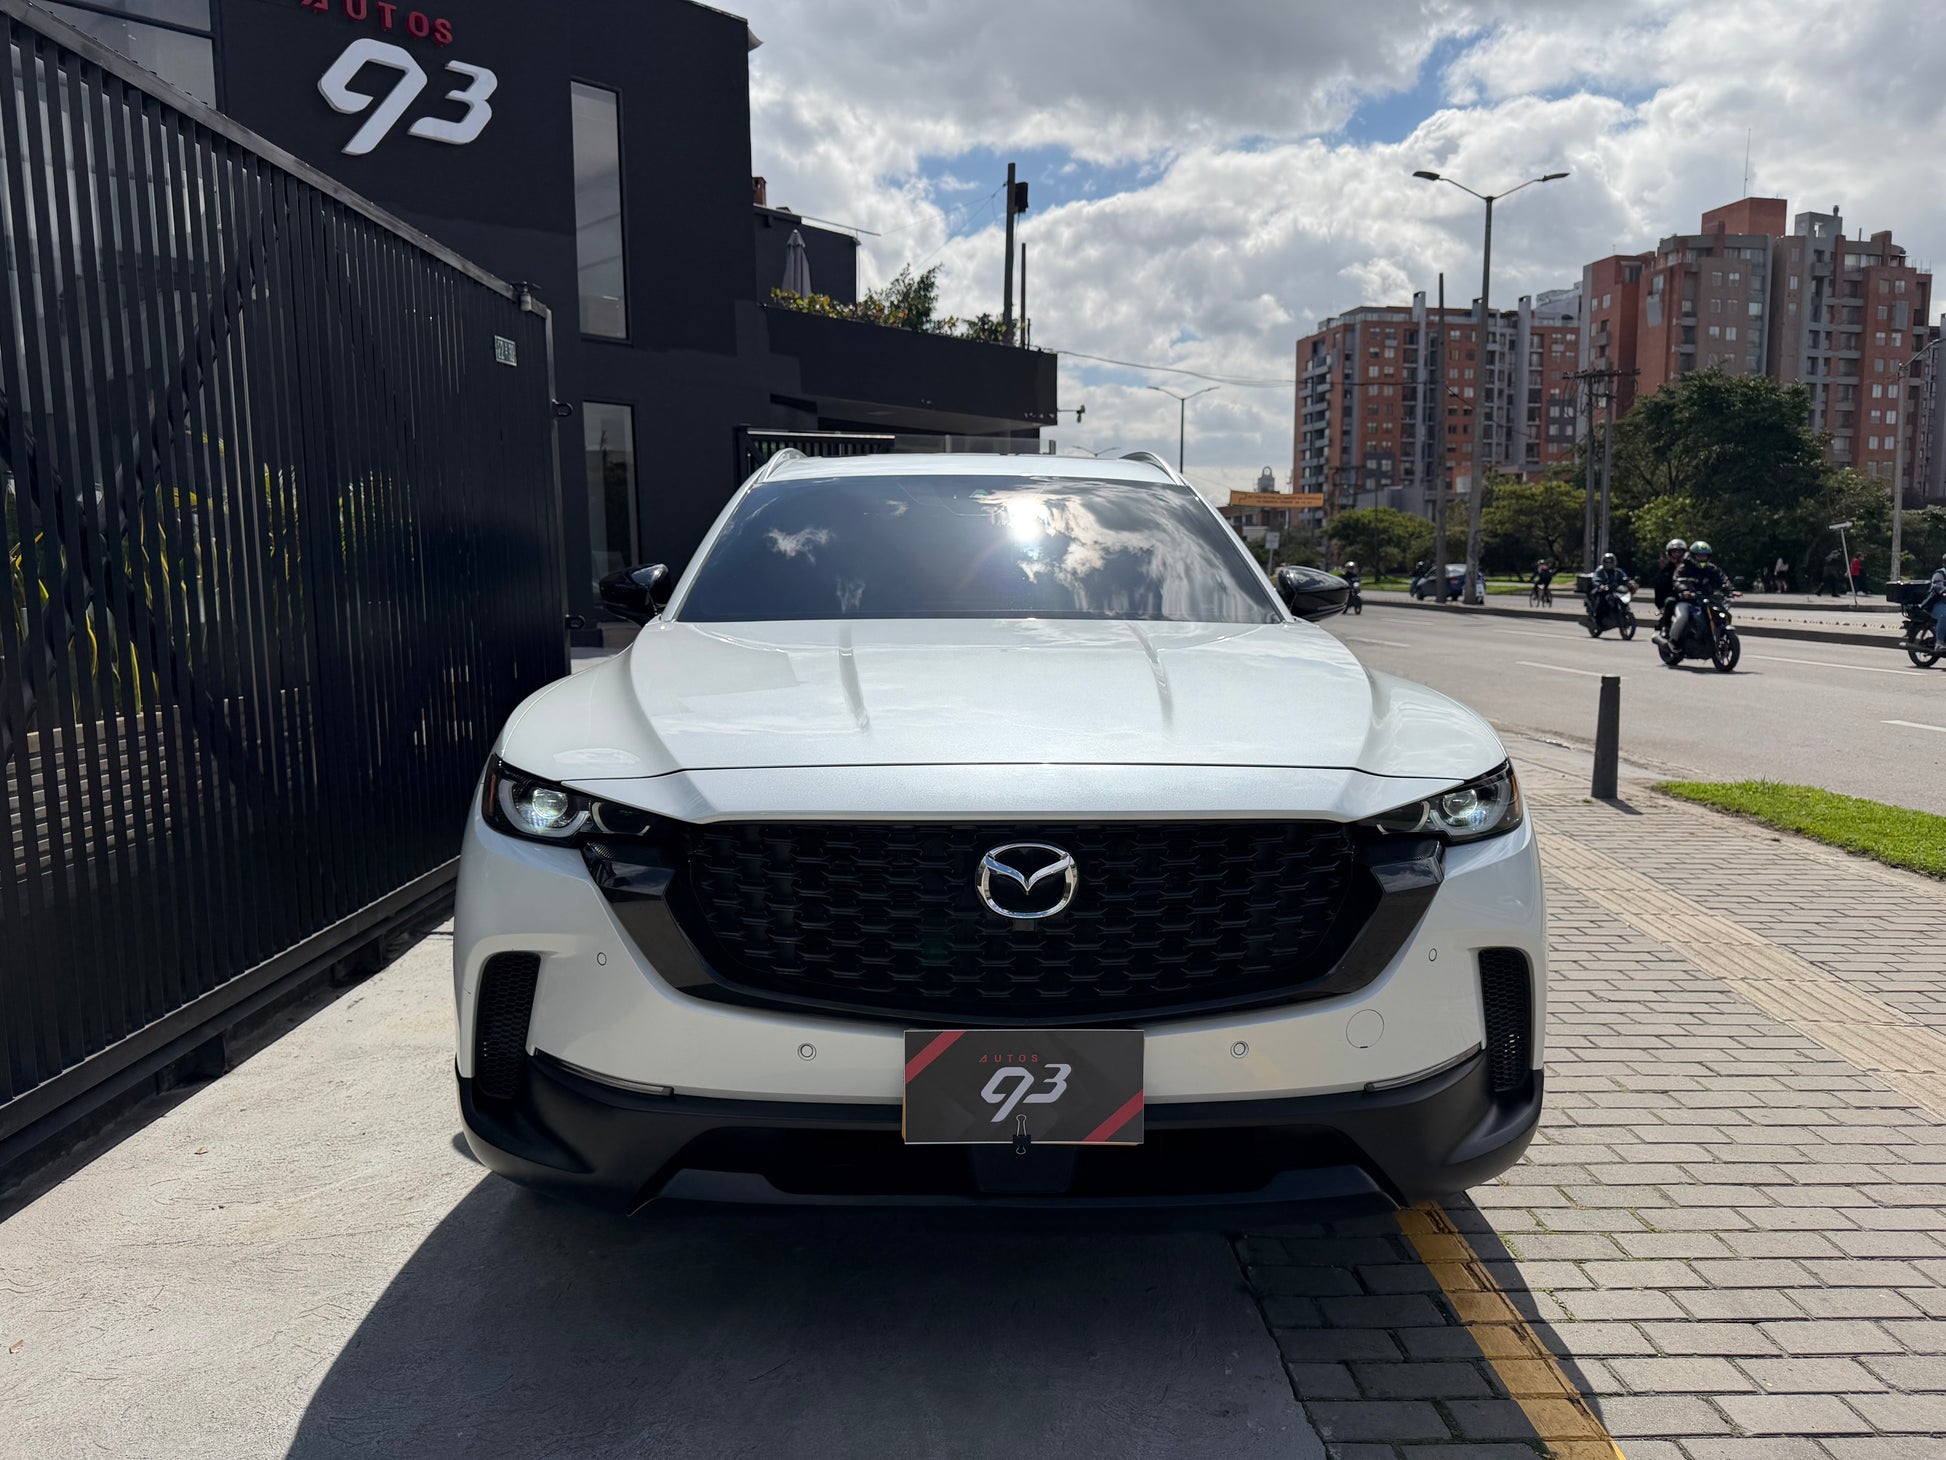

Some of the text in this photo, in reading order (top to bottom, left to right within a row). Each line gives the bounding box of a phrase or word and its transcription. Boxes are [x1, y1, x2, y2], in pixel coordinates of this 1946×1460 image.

[317, 38, 498, 156] 93
[978, 1054, 1039, 1063] AUTOS
[980, 1063, 1072, 1123] 93
